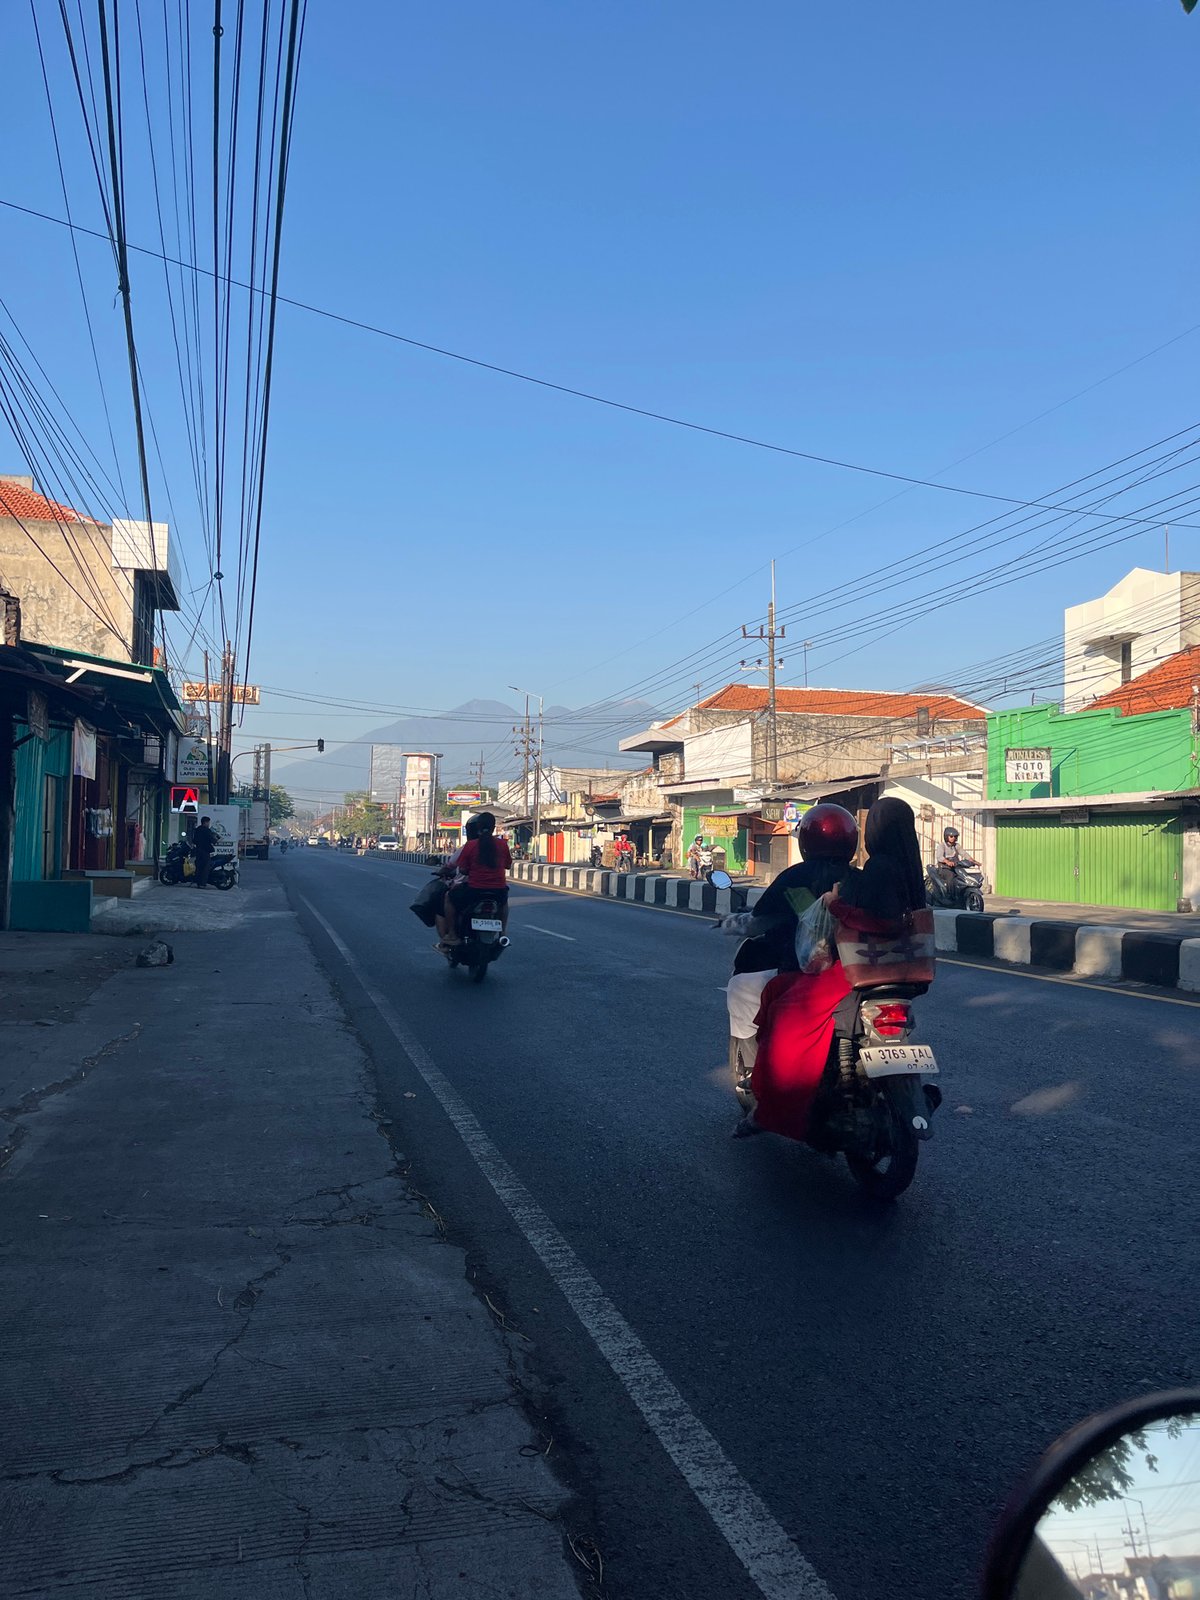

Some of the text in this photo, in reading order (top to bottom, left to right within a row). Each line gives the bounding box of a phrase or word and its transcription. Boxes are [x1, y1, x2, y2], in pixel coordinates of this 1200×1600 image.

[1016, 762, 1043, 771] FOTO
[864, 1048, 933, 1062] N 3769 TAL
